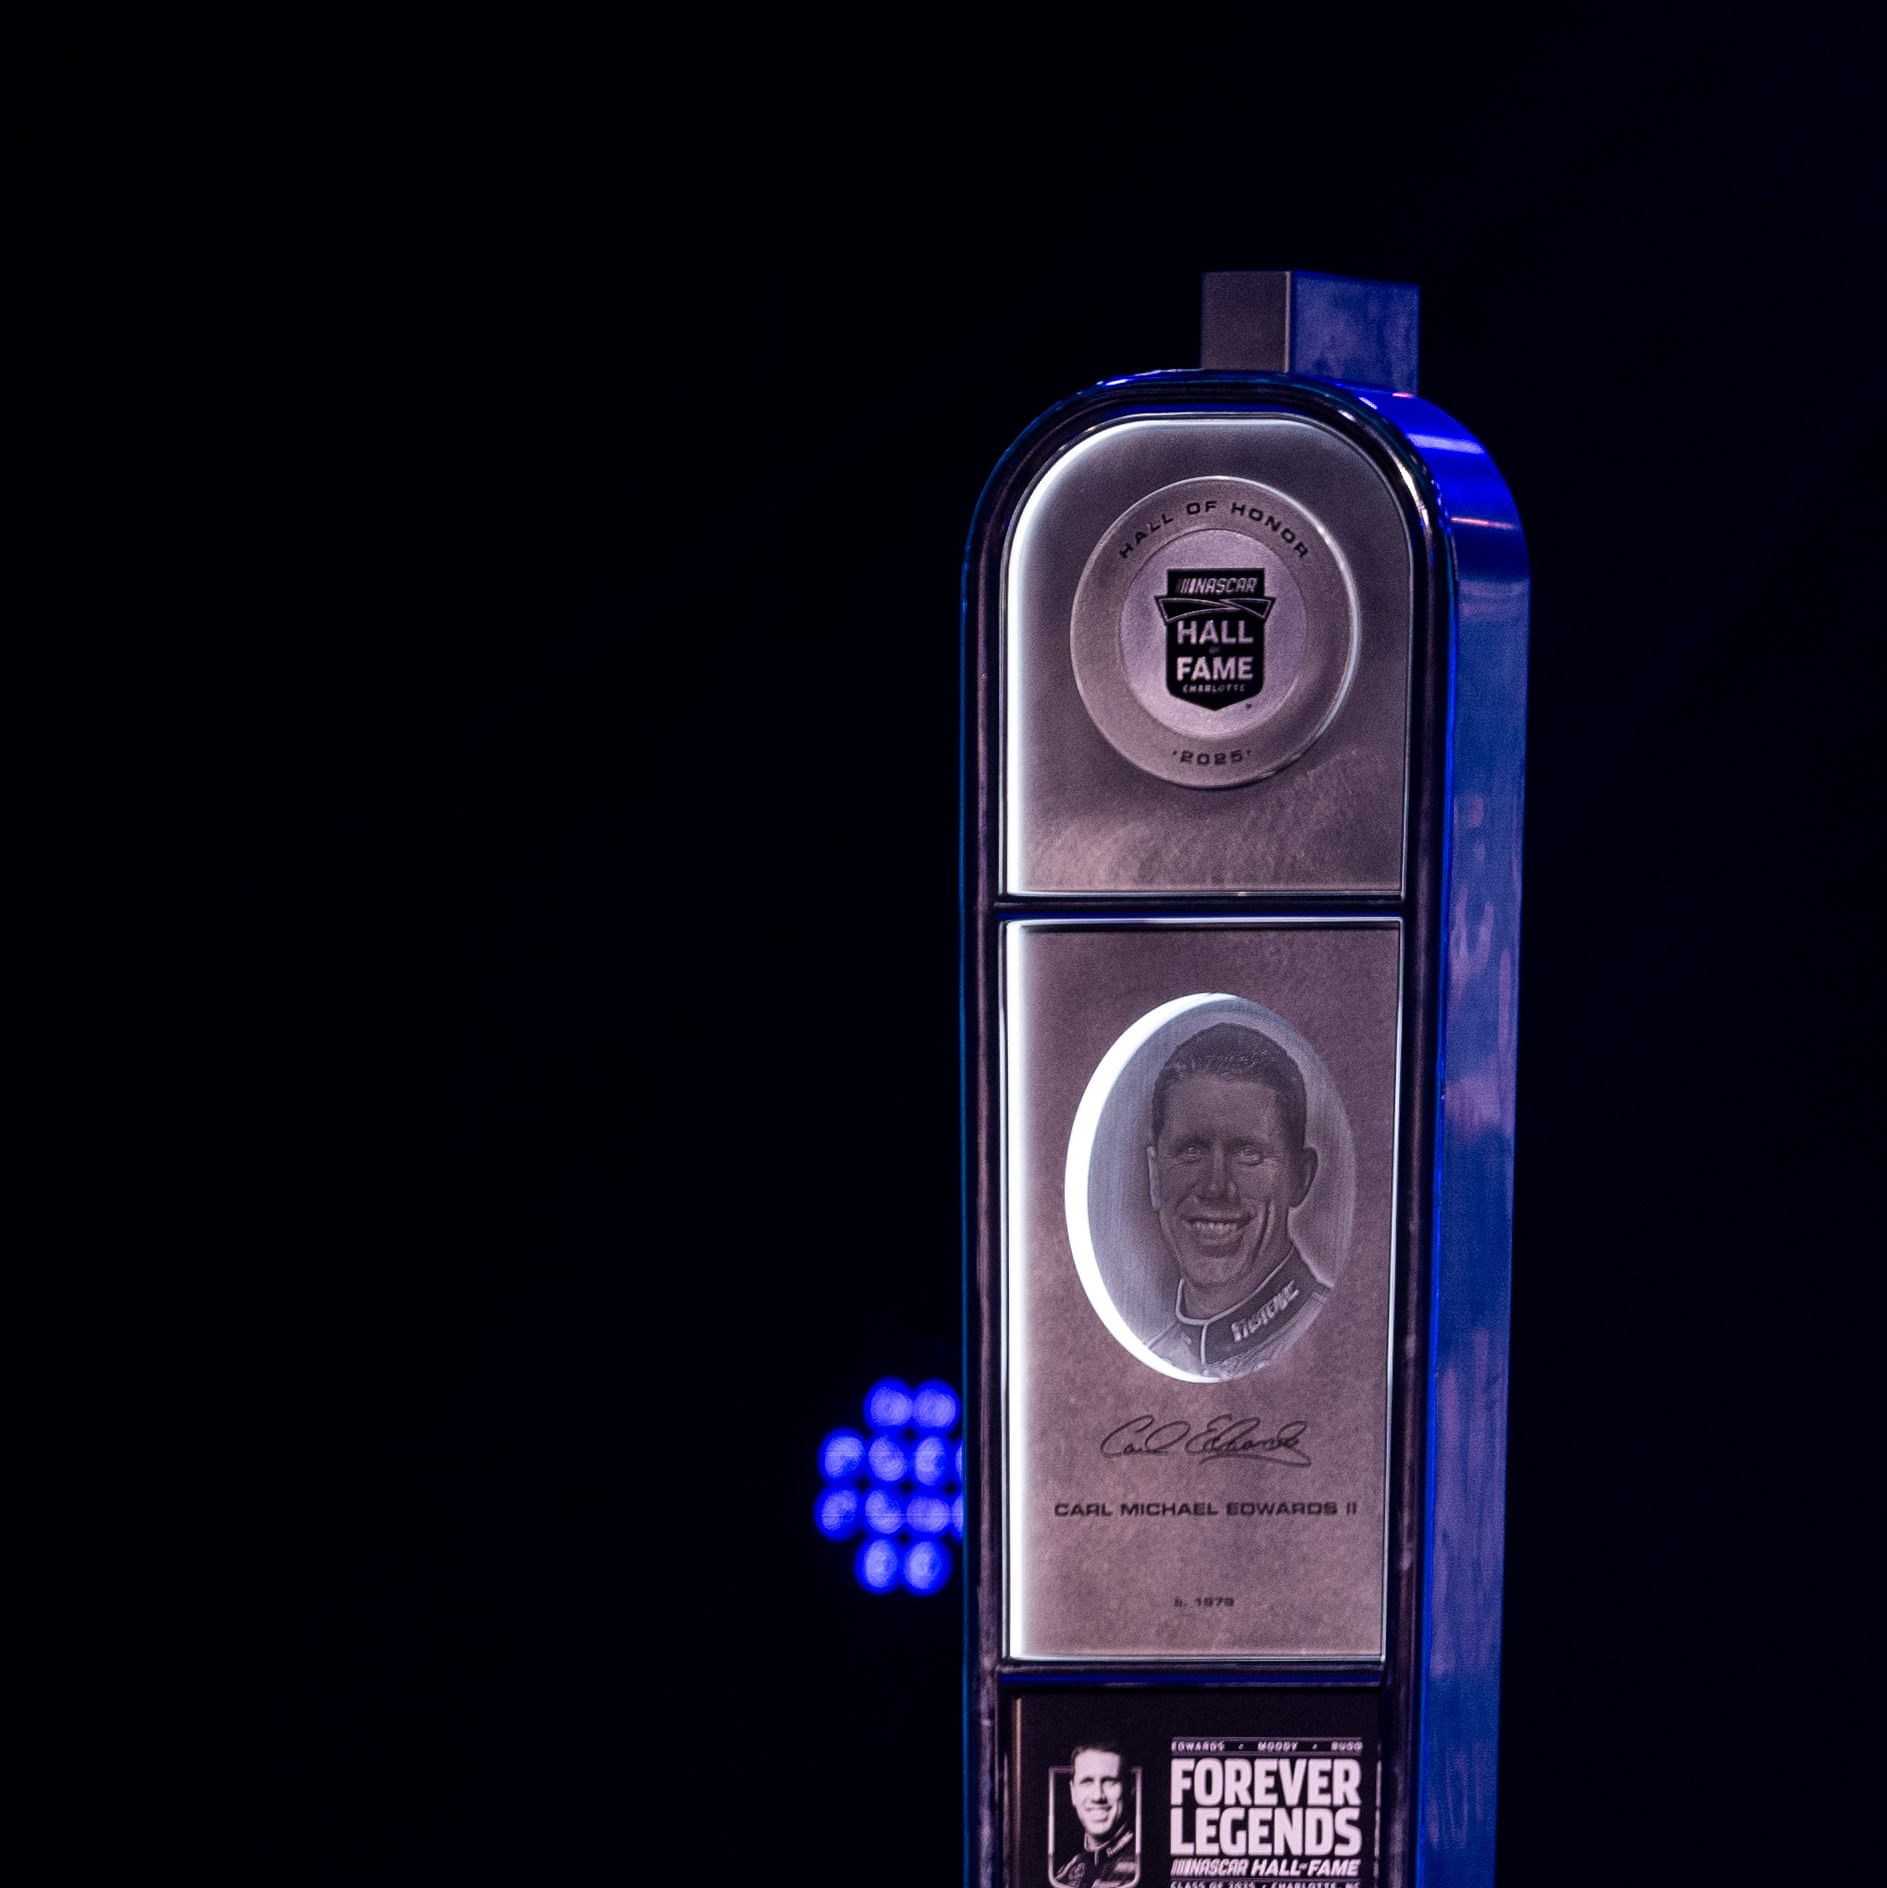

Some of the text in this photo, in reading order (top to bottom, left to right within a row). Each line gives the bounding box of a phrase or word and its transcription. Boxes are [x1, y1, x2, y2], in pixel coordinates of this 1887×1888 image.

[1119, 500, 1309, 559] HALL OF HONOR
[1194, 577, 1258, 593] NASCAR
[1177, 620, 1253, 644] HALL
[1176, 656, 1253, 680] FAME
[1180, 749, 1244, 766] 2025
[1054, 1501, 1358, 1517] CARL MICHAEL EDWARDS II
[1171, 1741, 1225, 1752] EDWARDS
[1257, 1741, 1298, 1751] MOODY
[1170, 1757, 1362, 1806] FOREVER
[1170, 1807, 1362, 1857] LEGENDS
[1189, 1859, 1249, 1877] NASCAR
[1250, 1859, 1300, 1877] HALL
[1307, 1859, 1361, 1877] FAME
